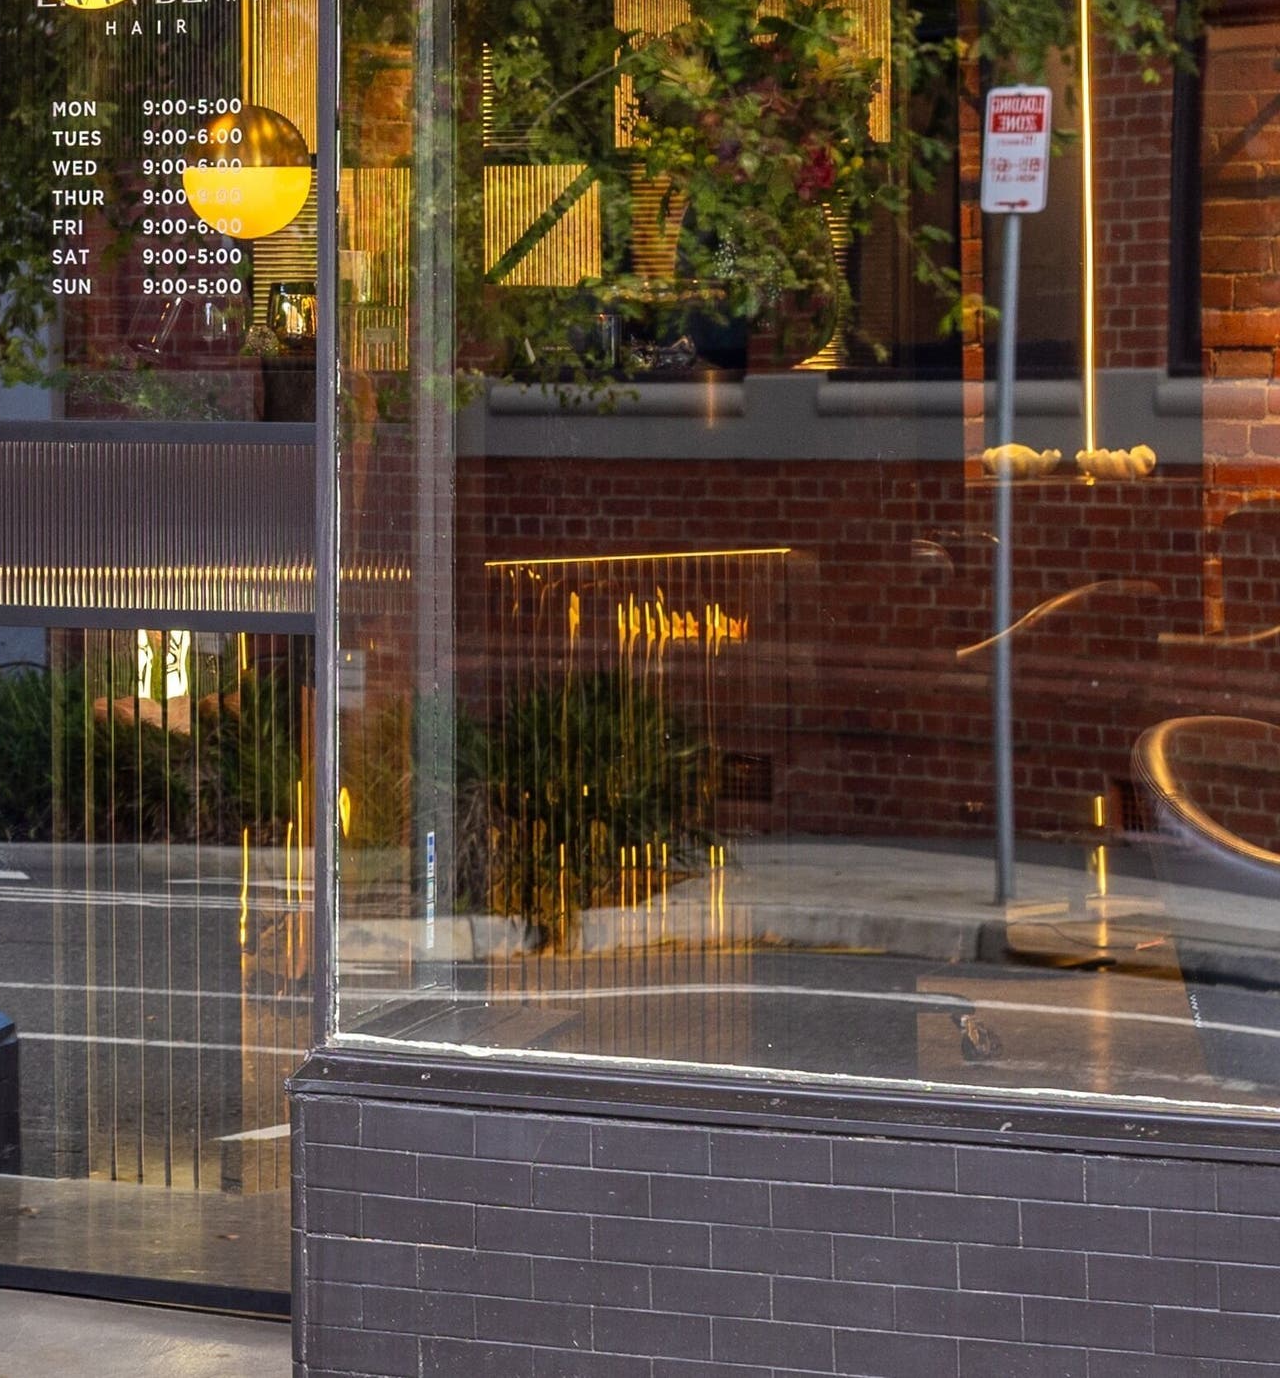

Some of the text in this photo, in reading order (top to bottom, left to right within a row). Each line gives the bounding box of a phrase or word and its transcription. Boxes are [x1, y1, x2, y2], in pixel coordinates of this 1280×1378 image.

[105, 18, 187, 36] HAIR
[52, 98, 242, 117] MON 9:00-5:00
[52, 128, 242, 146] TUES 9:00-6:00
[52, 160, 97, 176] WED
[52, 190, 105, 206] THUR
[52, 220, 83, 236] FRI
[52, 248, 242, 265] SAT 9:00-5:00
[52, 278, 242, 295] SUN 9:00-5:00
